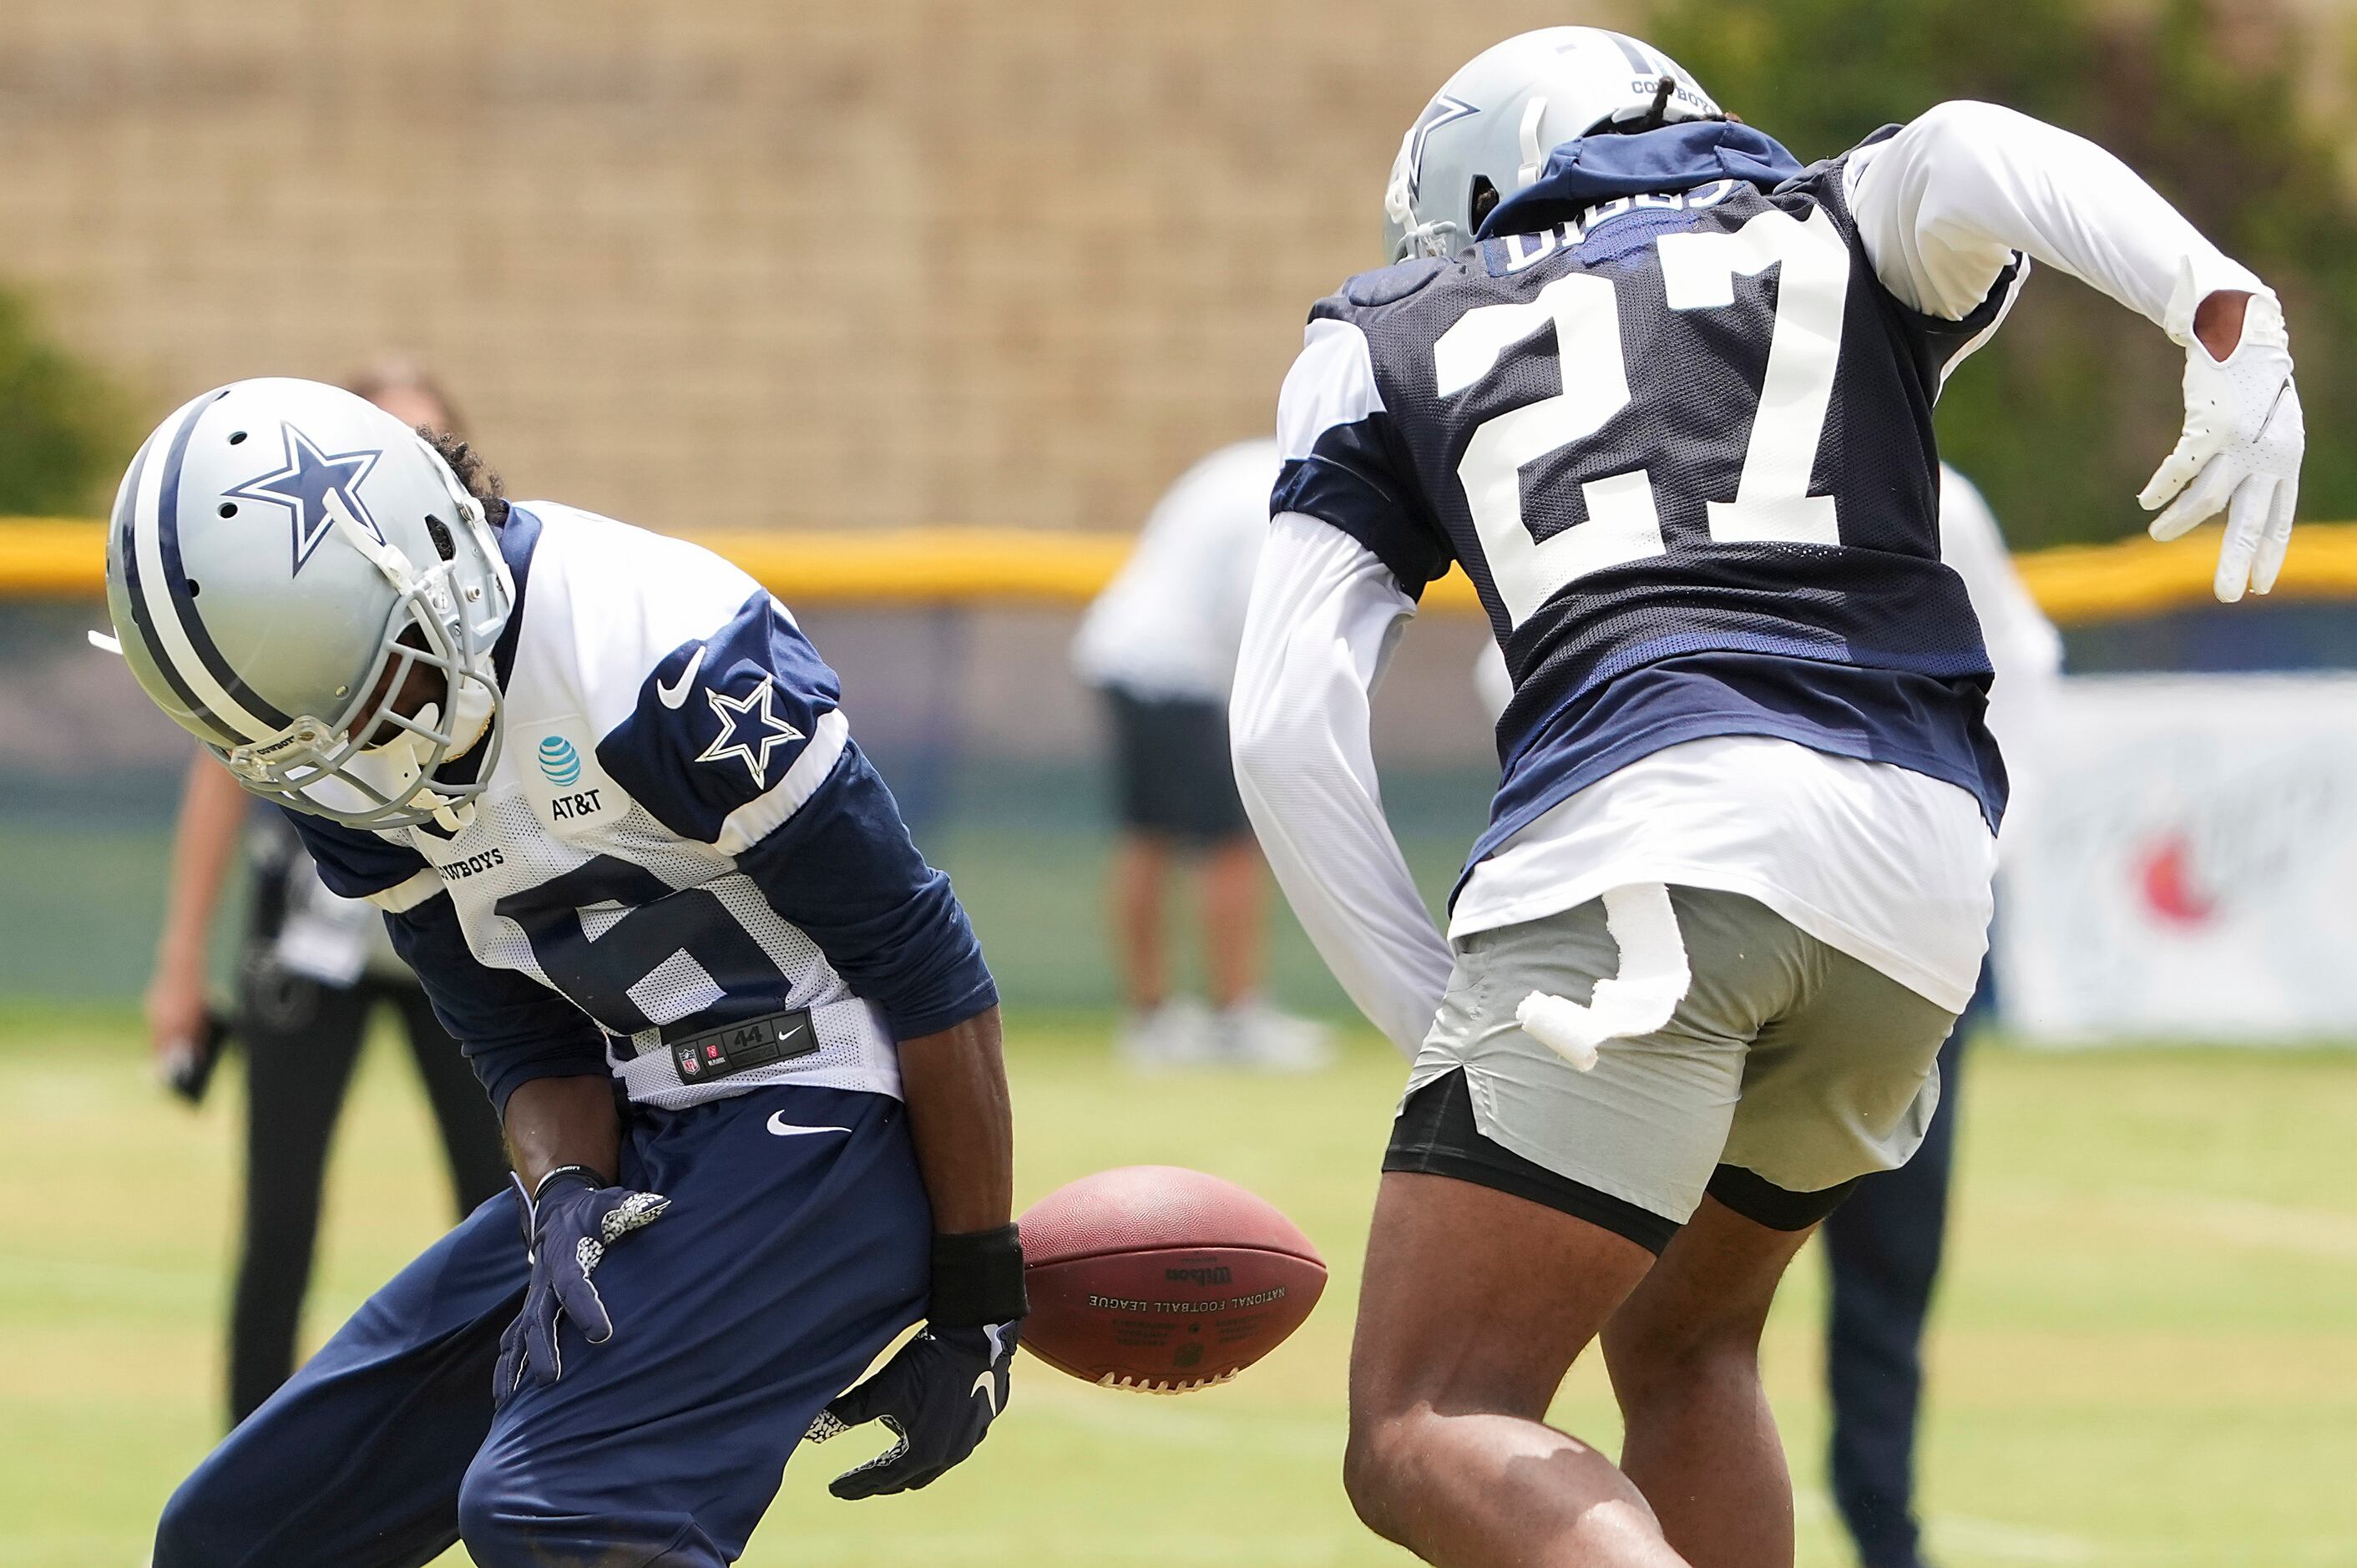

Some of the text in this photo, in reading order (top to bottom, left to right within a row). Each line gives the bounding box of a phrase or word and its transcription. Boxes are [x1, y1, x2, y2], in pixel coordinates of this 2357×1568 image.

[1631, 81, 1717, 115] COBOYS
[1434, 204, 1850, 632] 27
[256, 735, 295, 755] COWBOY
[552, 788, 601, 821] AT&T
[494, 853, 794, 1045] 6
[735, 1024, 763, 1047] 44
[1165, 1266, 1233, 1286] Wilson
[1089, 1287, 1287, 1313] NATIONAL FOOTBALL LEAGUE
